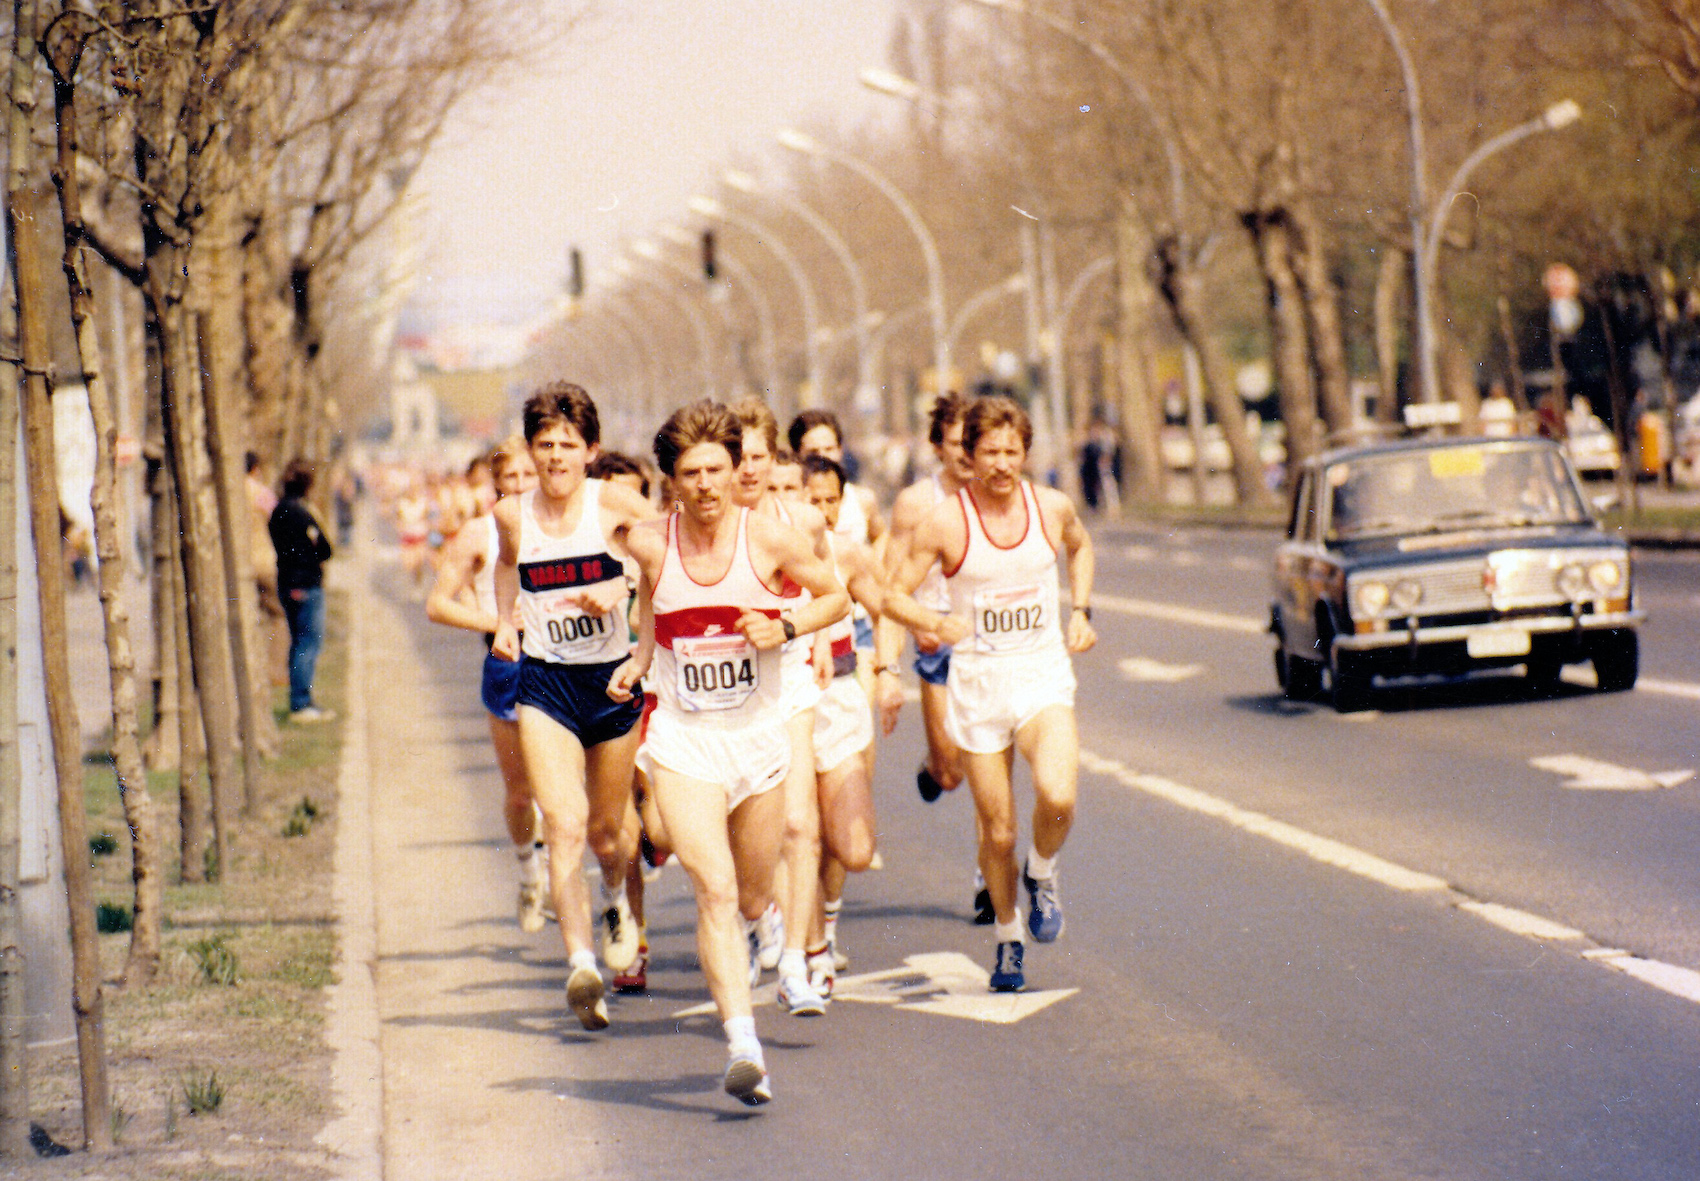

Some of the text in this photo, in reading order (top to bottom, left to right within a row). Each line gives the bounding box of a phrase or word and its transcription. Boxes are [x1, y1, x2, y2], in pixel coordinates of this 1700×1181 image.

[548, 615, 604, 644] 0001
[984, 604, 1043, 633] 0002
[684, 658, 754, 692] 0004
